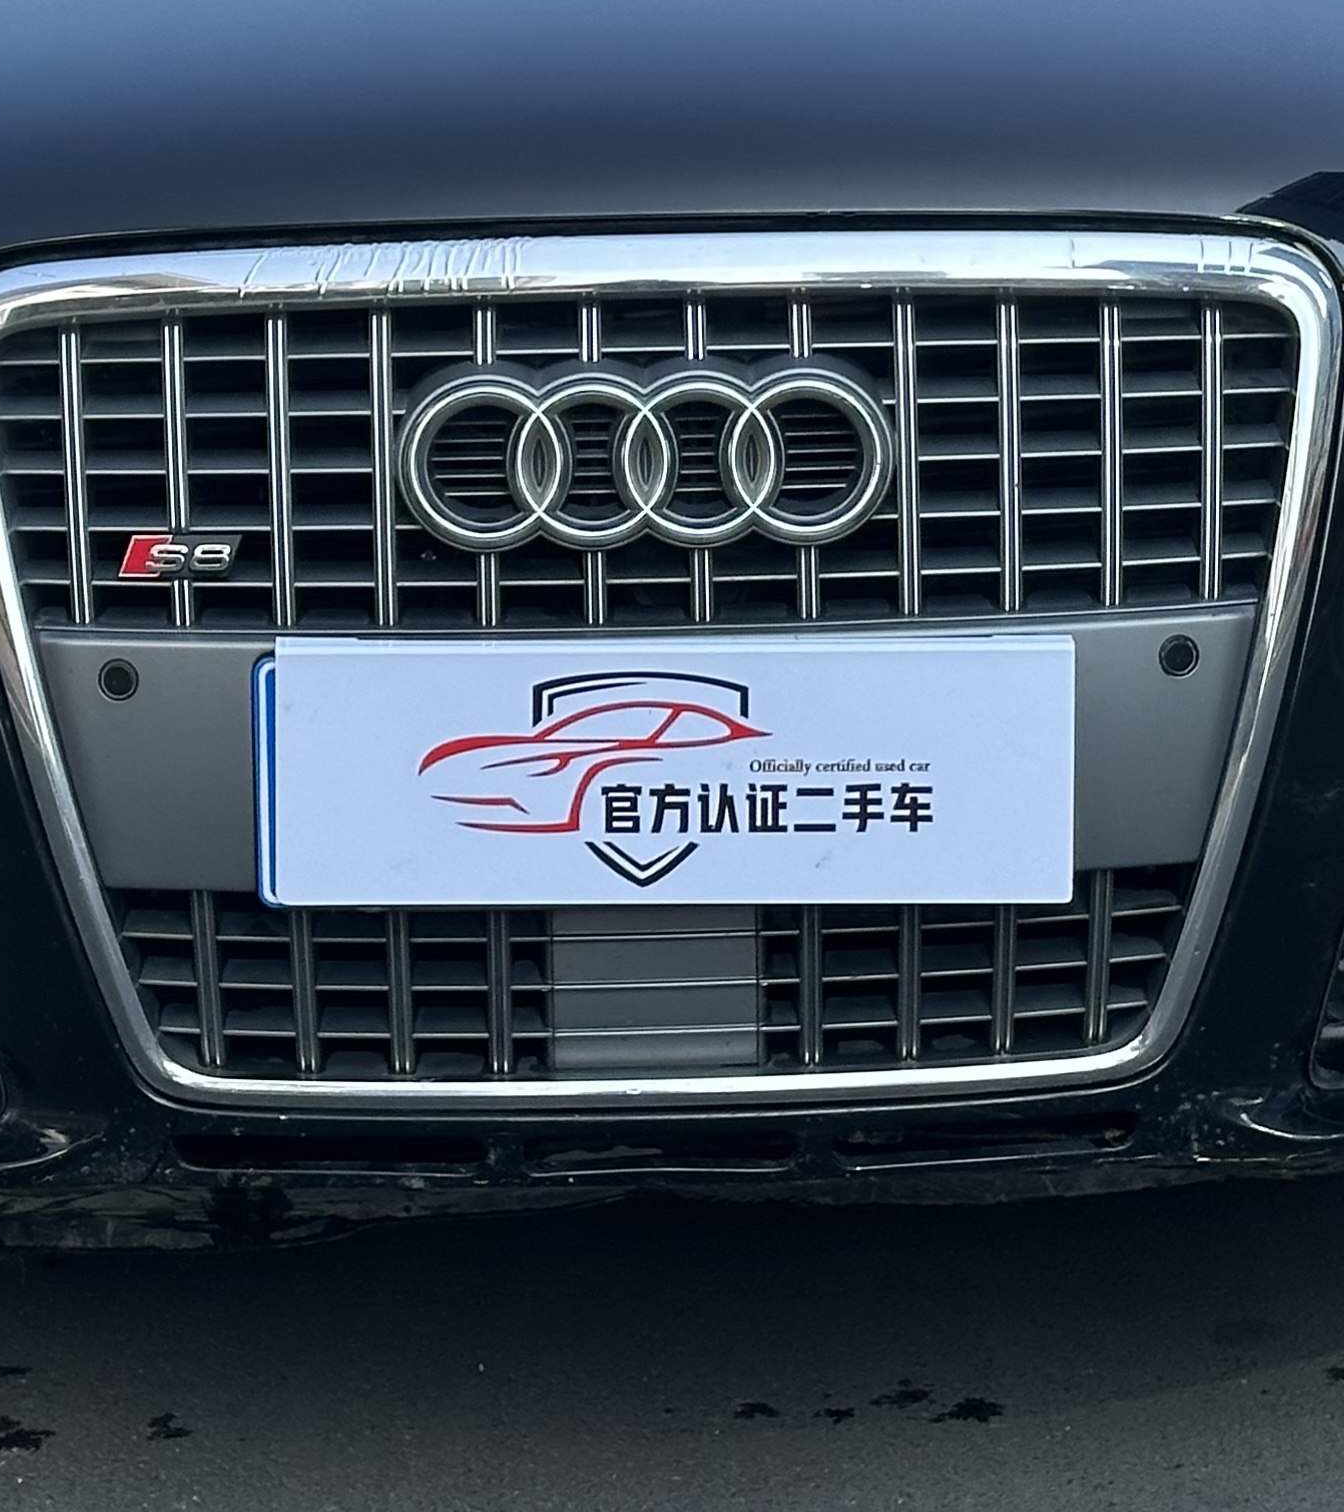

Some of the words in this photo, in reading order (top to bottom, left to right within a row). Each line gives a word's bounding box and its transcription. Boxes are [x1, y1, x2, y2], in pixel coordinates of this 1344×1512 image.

[145, 544, 230, 572] S8
[749, 759, 812, 777] Officially
[815, 759, 871, 773] certified
[875, 759, 906, 773] used
[909, 762, 931, 773] car
[601, 782, 934, 834] 官方认证二手车
